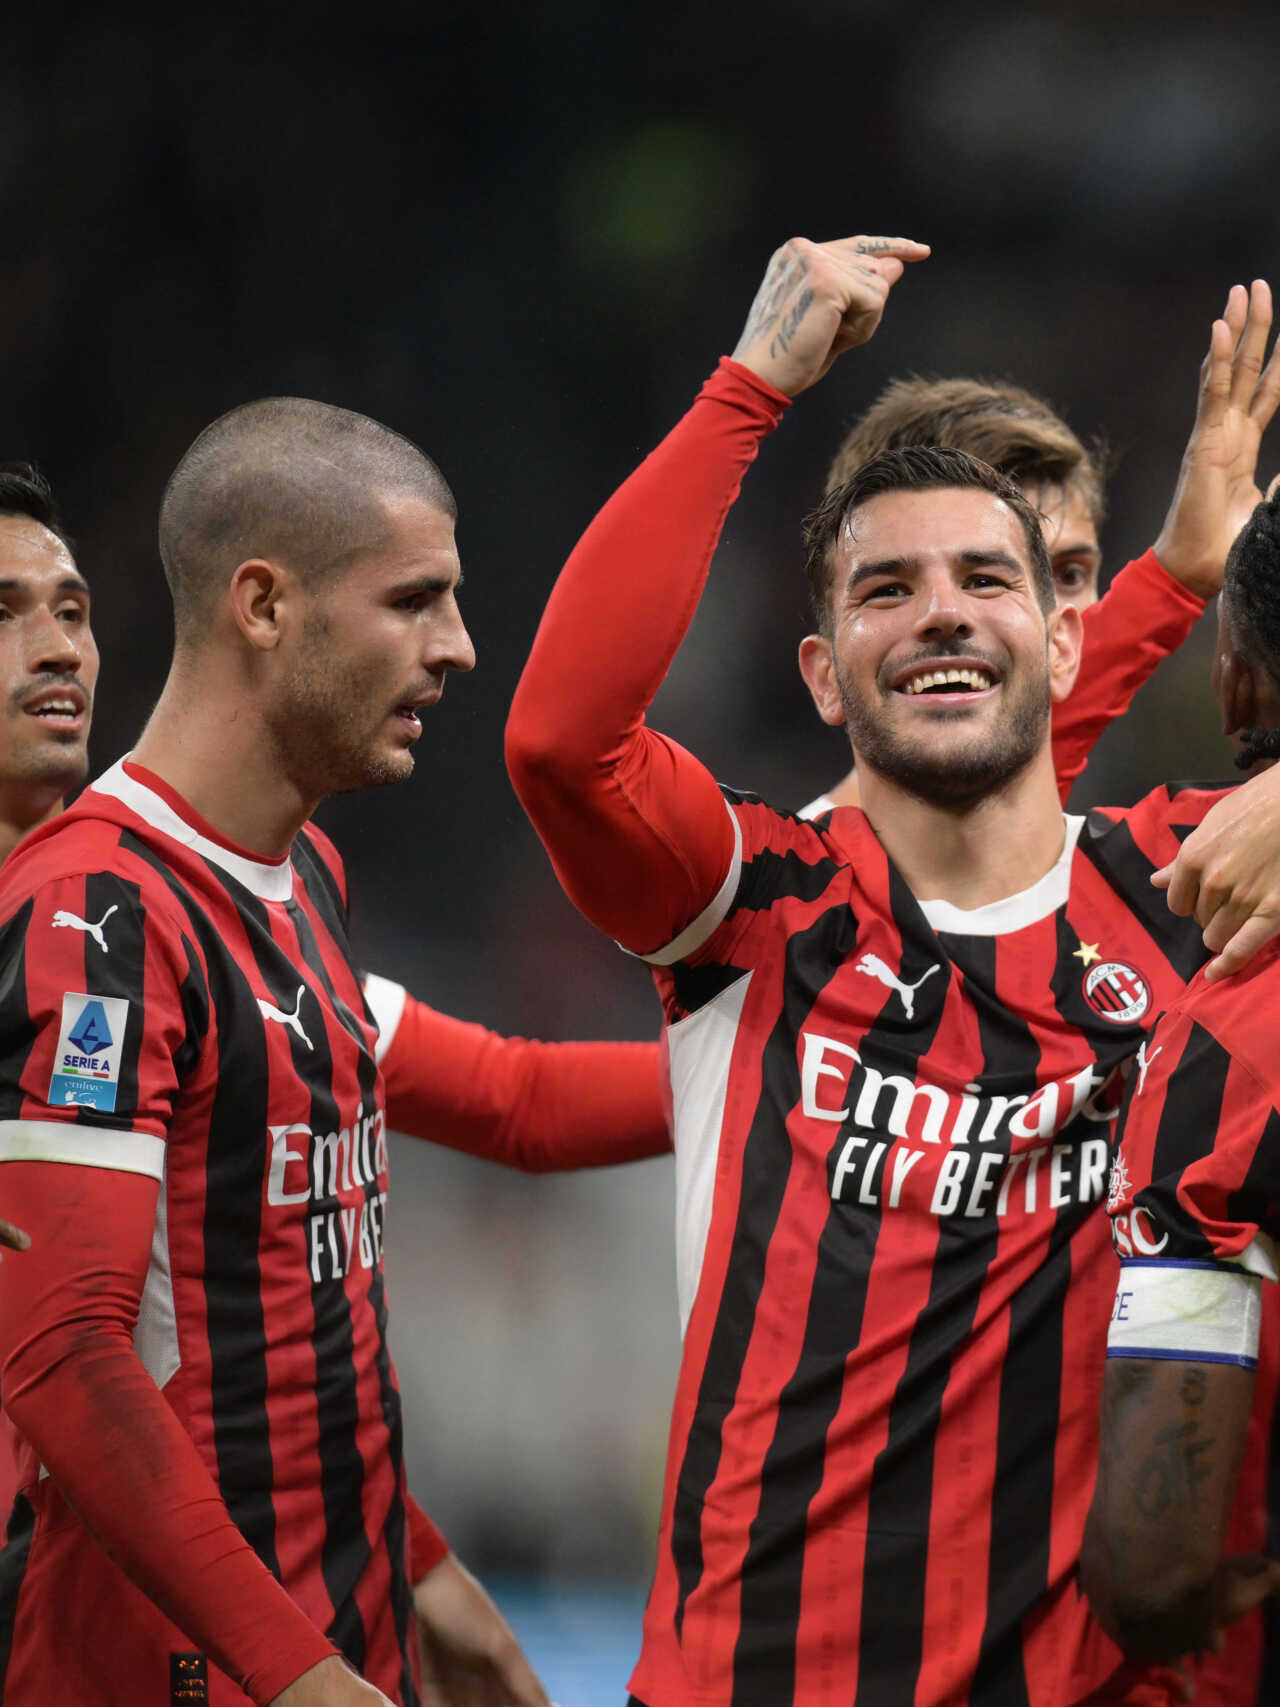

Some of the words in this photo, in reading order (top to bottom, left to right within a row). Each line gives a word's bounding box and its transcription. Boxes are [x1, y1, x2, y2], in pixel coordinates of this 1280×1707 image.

[63, 1054, 98, 1069] SERIE
[101, 1060, 110, 1072] A
[267, 1101, 388, 1206] Emira
[831, 1136, 926, 1208] FLY
[930, 1139, 1107, 1217] BETTER
[311, 1206, 356, 1283] FLY
[359, 1192, 388, 1269] BE
[1111, 1206, 1170, 1258] SC
